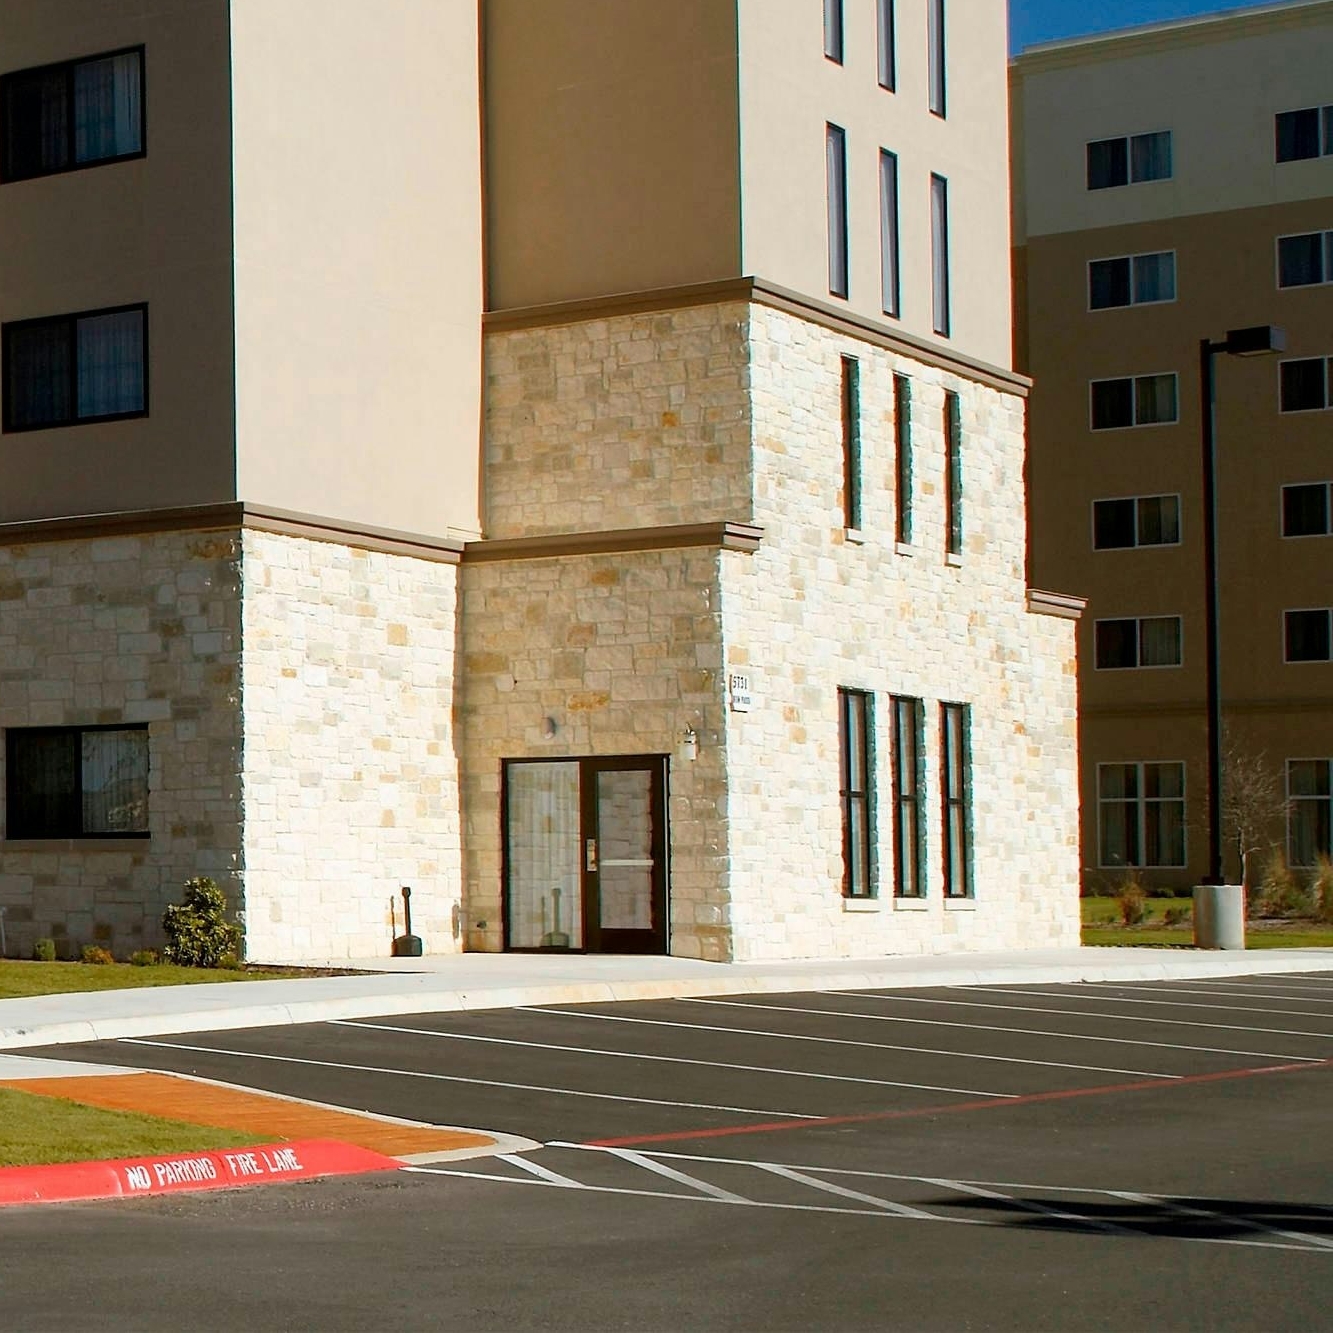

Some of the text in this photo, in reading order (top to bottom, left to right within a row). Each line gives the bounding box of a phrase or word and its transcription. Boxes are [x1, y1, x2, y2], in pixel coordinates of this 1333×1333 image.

[125, 1148, 303, 1190] NO PARKING FIRE LANE
